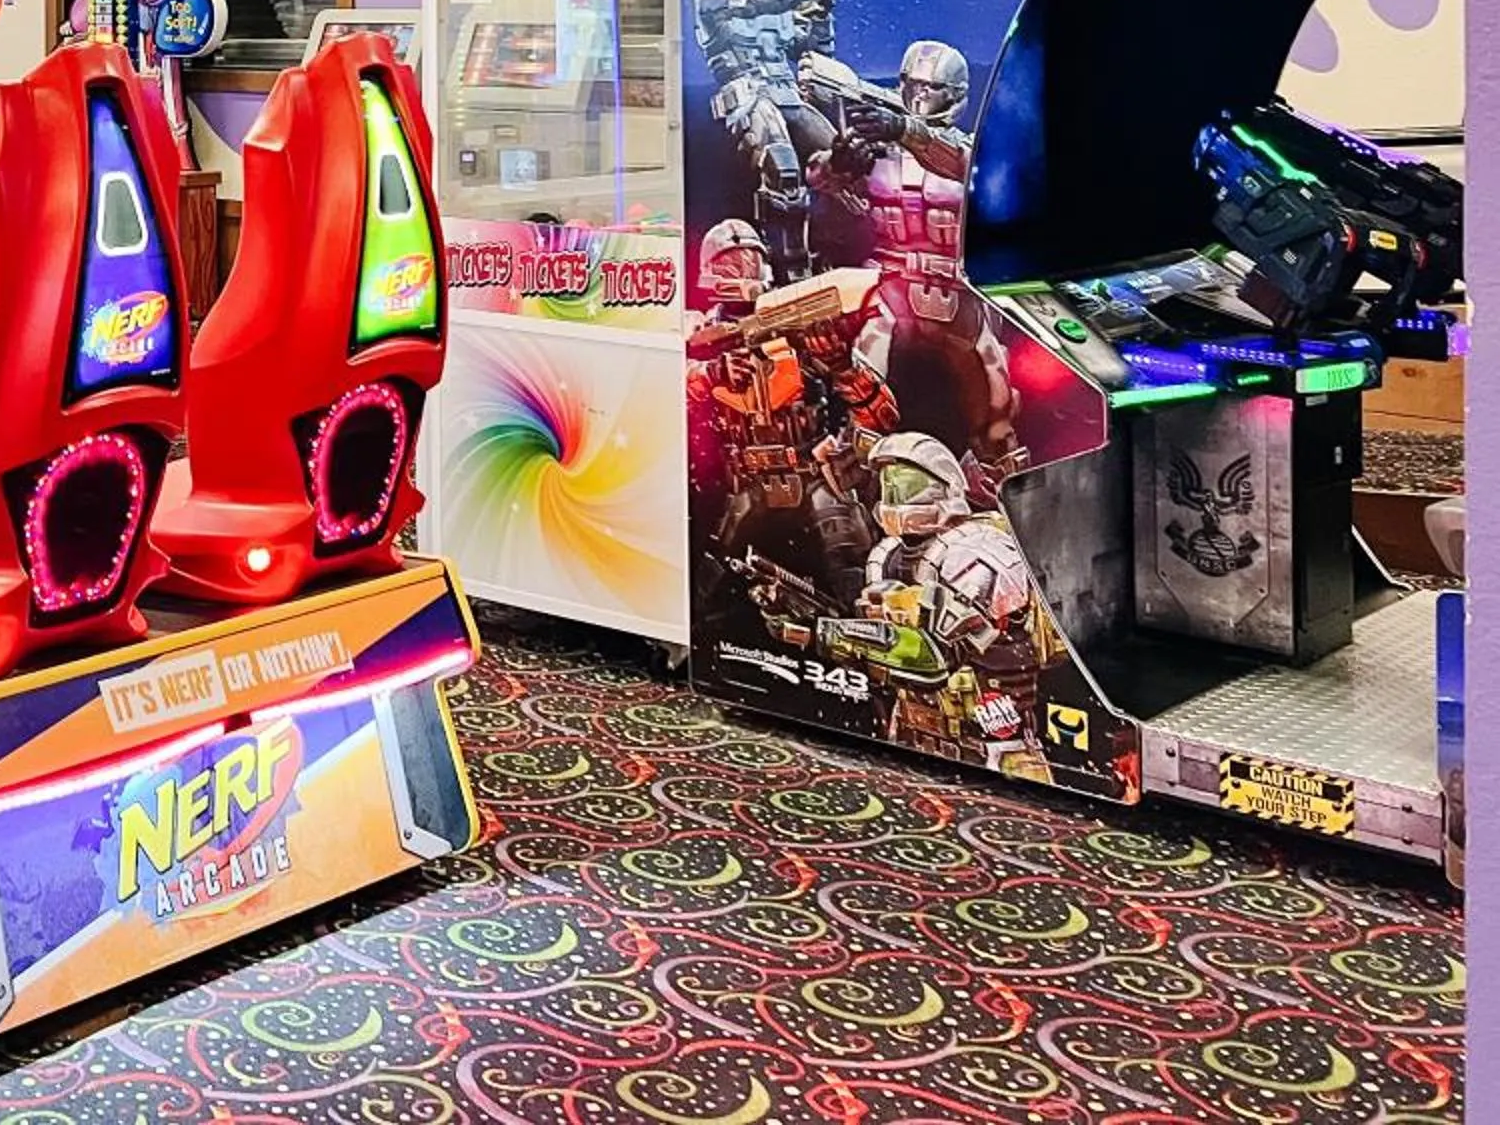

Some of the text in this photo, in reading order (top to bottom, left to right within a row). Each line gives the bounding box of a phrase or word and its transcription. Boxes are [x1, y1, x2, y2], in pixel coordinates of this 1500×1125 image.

[446, 242, 677, 308] TICKETS TICKETS TICKETS
[91, 297, 165, 347] NERF
[110, 682, 158, 722] IT'S
[160, 663, 219, 709] NERF
[224, 657, 256, 693] OR
[803, 660, 869, 692] 343
[1250, 766, 1323, 796] CAUTION
[1261, 786, 1311, 809] WATCH
[116, 715, 296, 903] NERF
[1245, 793, 1327, 824] YOUR STEP
[155, 834, 291, 917] ARCADE
